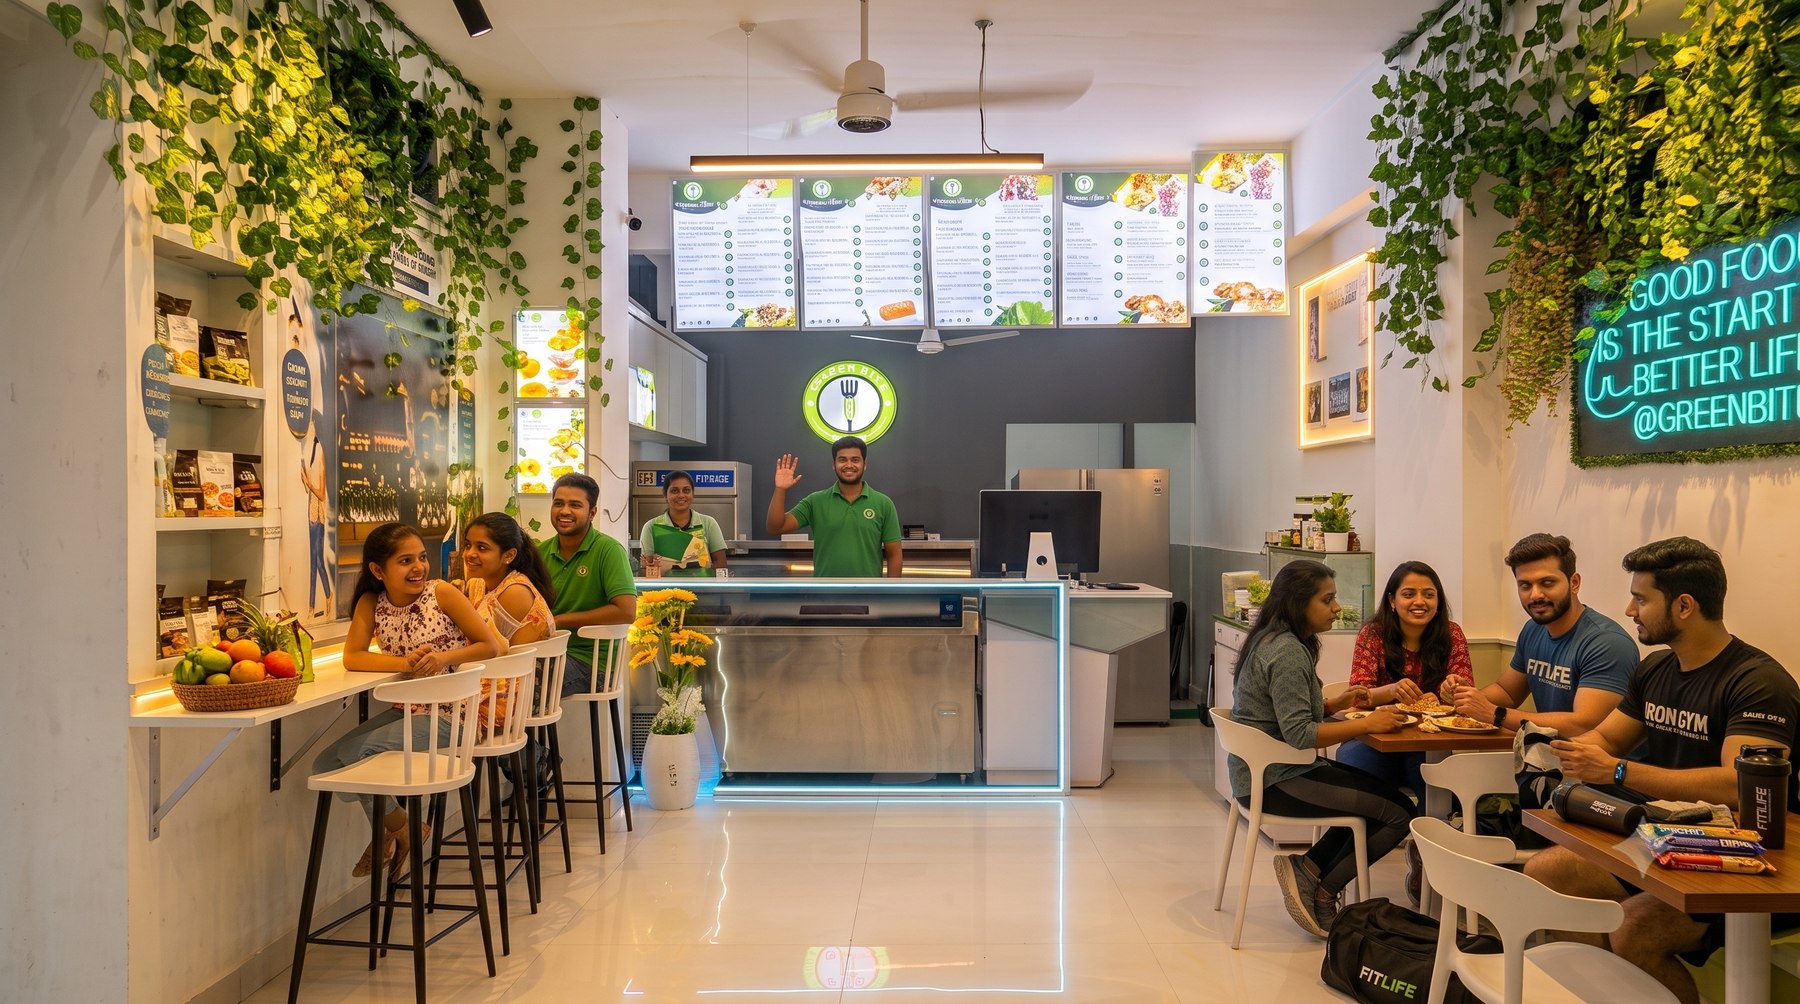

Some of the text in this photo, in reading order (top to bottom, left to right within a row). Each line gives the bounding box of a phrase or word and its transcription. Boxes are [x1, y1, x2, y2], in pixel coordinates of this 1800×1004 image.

[1630, 232, 1800, 312] GOOD FOO
[1598, 282, 1800, 362] IS THE START
[1633, 332, 1800, 396] BETTER LIF
[1633, 384, 1800, 440] @GREENBIT
[1645, 701, 1678, 727] IRON
[1678, 710, 1709, 735] GYM
[1359, 965, 1418, 999] FITLIFE
